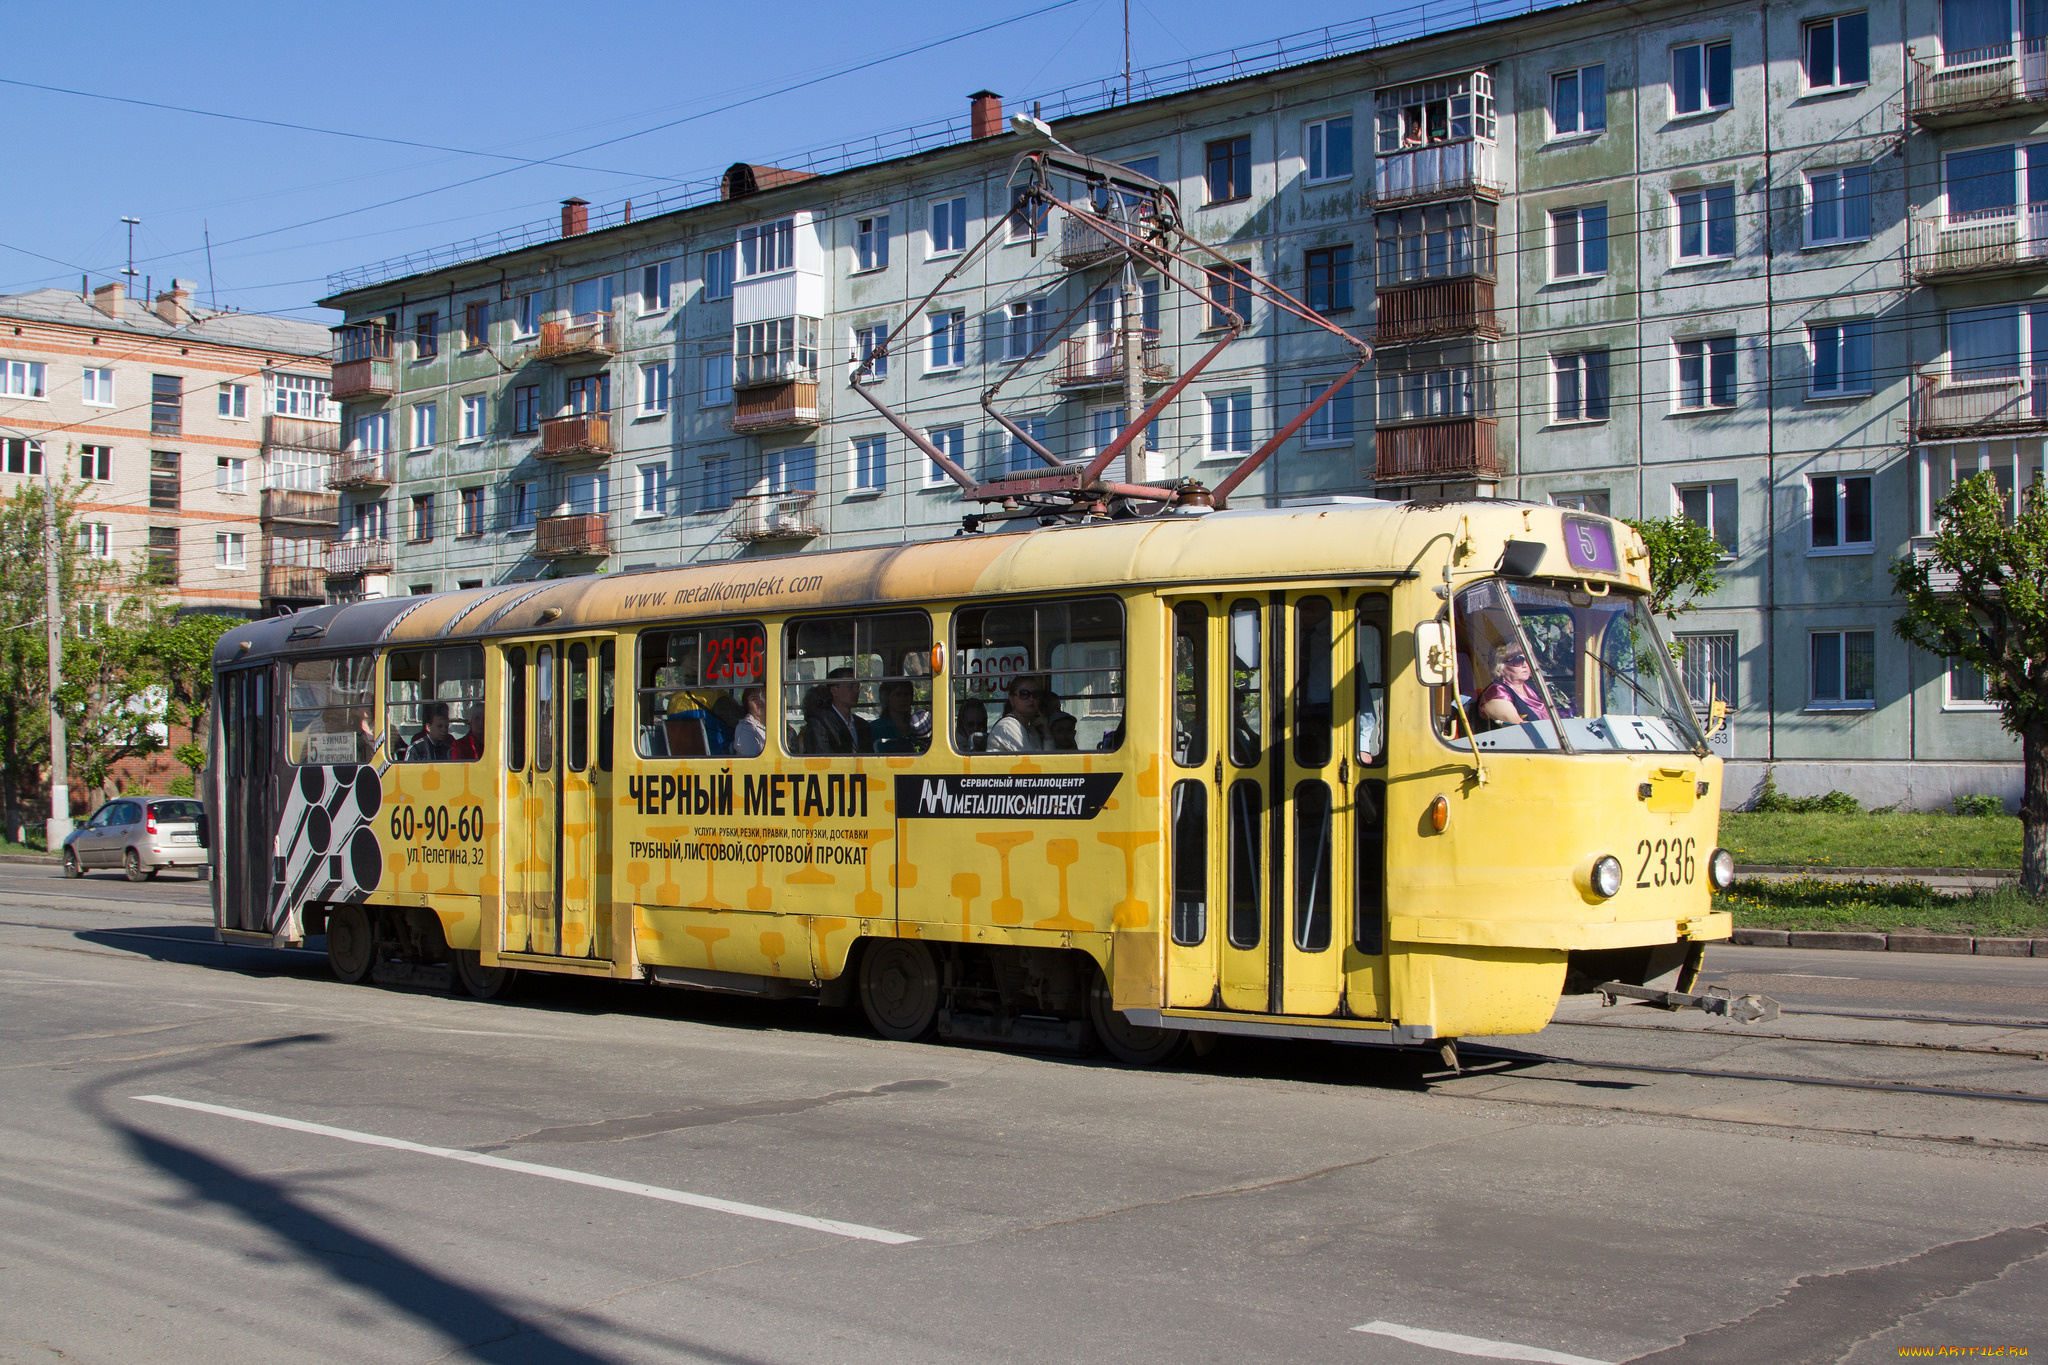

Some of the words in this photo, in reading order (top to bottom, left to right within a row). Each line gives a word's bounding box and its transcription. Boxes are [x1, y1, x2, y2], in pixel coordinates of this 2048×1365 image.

[1576, 523, 1597, 562] 5
[624, 591, 667, 609] www.
[674, 576, 785, 604] metallkomplekt.
[789, 575, 823, 593] com
[706, 636, 763, 679] 2336
[310, 736, 318, 763] 5
[629, 767, 733, 815] ЧЕРНЫЙ
[744, 773, 867, 817] МЕТАЛЛ
[960, 776, 1013, 787] СЕРВИСНЫЙ
[1015, 778, 1086, 789] МЕТАЛЛОЦЕНТР
[953, 794, 1086, 815] МЕТАЛЛКОМПЛЕКТ
[391, 805, 484, 843] 60-90-60
[694, 827, 717, 837] УСЛУГИ
[762, 828, 791, 840] ПРАВКИ,
[791, 829, 828, 841] ПОГРУЗКИ,
[829, 830, 868, 841] ДОСТАВКИ
[407, 848, 420, 866] ул.
[472, 848, 484, 865] 32
[816, 846, 868, 865] ПРОКАТ
[1636, 837, 1695, 889] 2336
